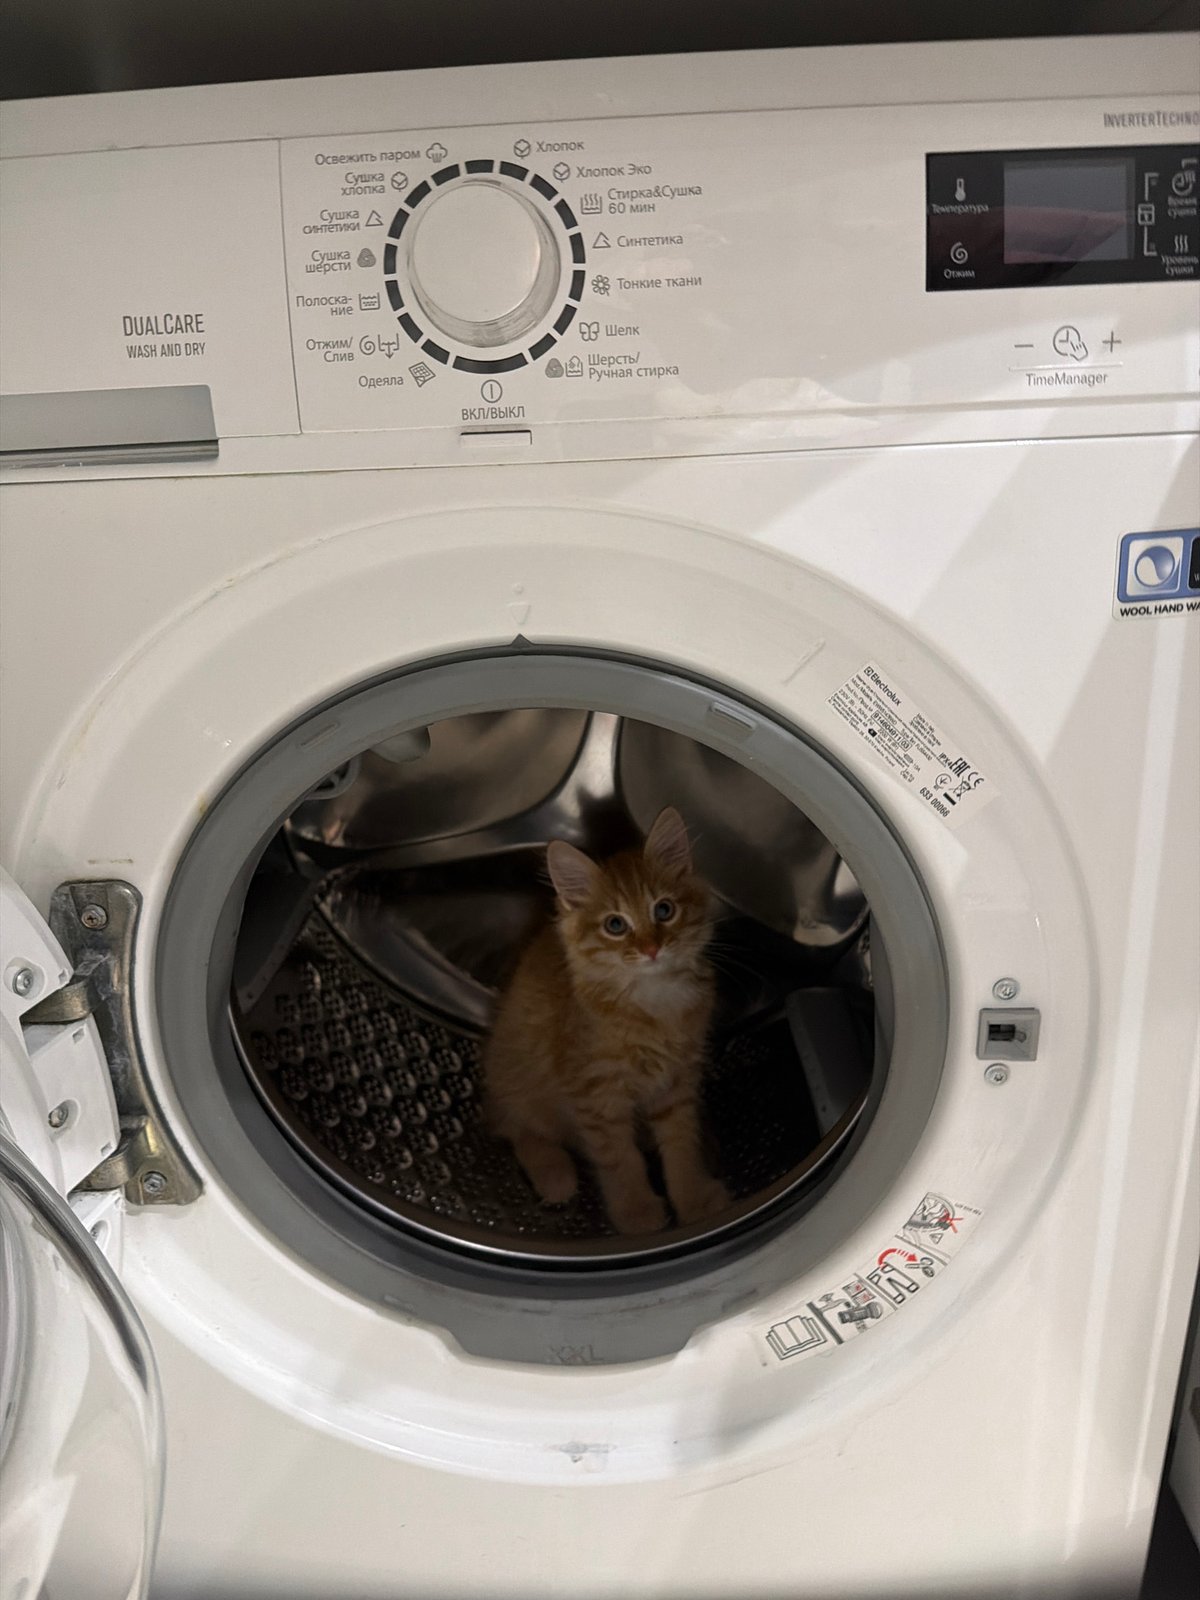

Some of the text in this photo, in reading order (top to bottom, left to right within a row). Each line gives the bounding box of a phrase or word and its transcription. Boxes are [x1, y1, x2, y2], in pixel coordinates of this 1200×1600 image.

[536, 140, 585, 153] Хлопок
[314, 150, 421, 166] Освежить паром
[576, 163, 652, 179] Хлопок Эко
[345, 172, 385, 186] Сушка
[341, 184, 386, 196] хлопка
[607, 184, 702, 201] Стирка&Сушка
[608, 202, 656, 214] 60 мин
[319, 209, 359, 223] Сушка
[302, 221, 360, 234] синтетики
[616, 233, 684, 248] Синтетика
[311, 249, 351, 264] Сушка
[305, 261, 351, 274] шерсти
[616, 275, 703, 290] Тонкие ткани
[295, 296, 352, 308] Полоска-
[330, 306, 354, 316] ние
[122, 313, 205, 336] DUALCARE
[604, 323, 641, 337] Шелк
[126, 342, 206, 359] WASH AND DRY
[305, 336, 354, 351] Отжим/
[323, 350, 355, 363] Слив
[588, 352, 641, 367] Шерсть/
[588, 364, 680, 381] Ручная стирка
[1026, 372, 1109, 387] TimeManager
[358, 375, 404, 389] Одеяла
[461, 405, 526, 421] ВКЛ/ВЫКЛ
[1120, 606, 1153, 617] WOOL
[1154, 603, 1184, 614] HAND
[870, 672, 902, 707] Electrolux
[901, 739, 911, 750] 03
[938, 752, 953, 770] IPX4
[968, 771, 984, 788] CE
[919, 786, 950, 818] 633 00066
